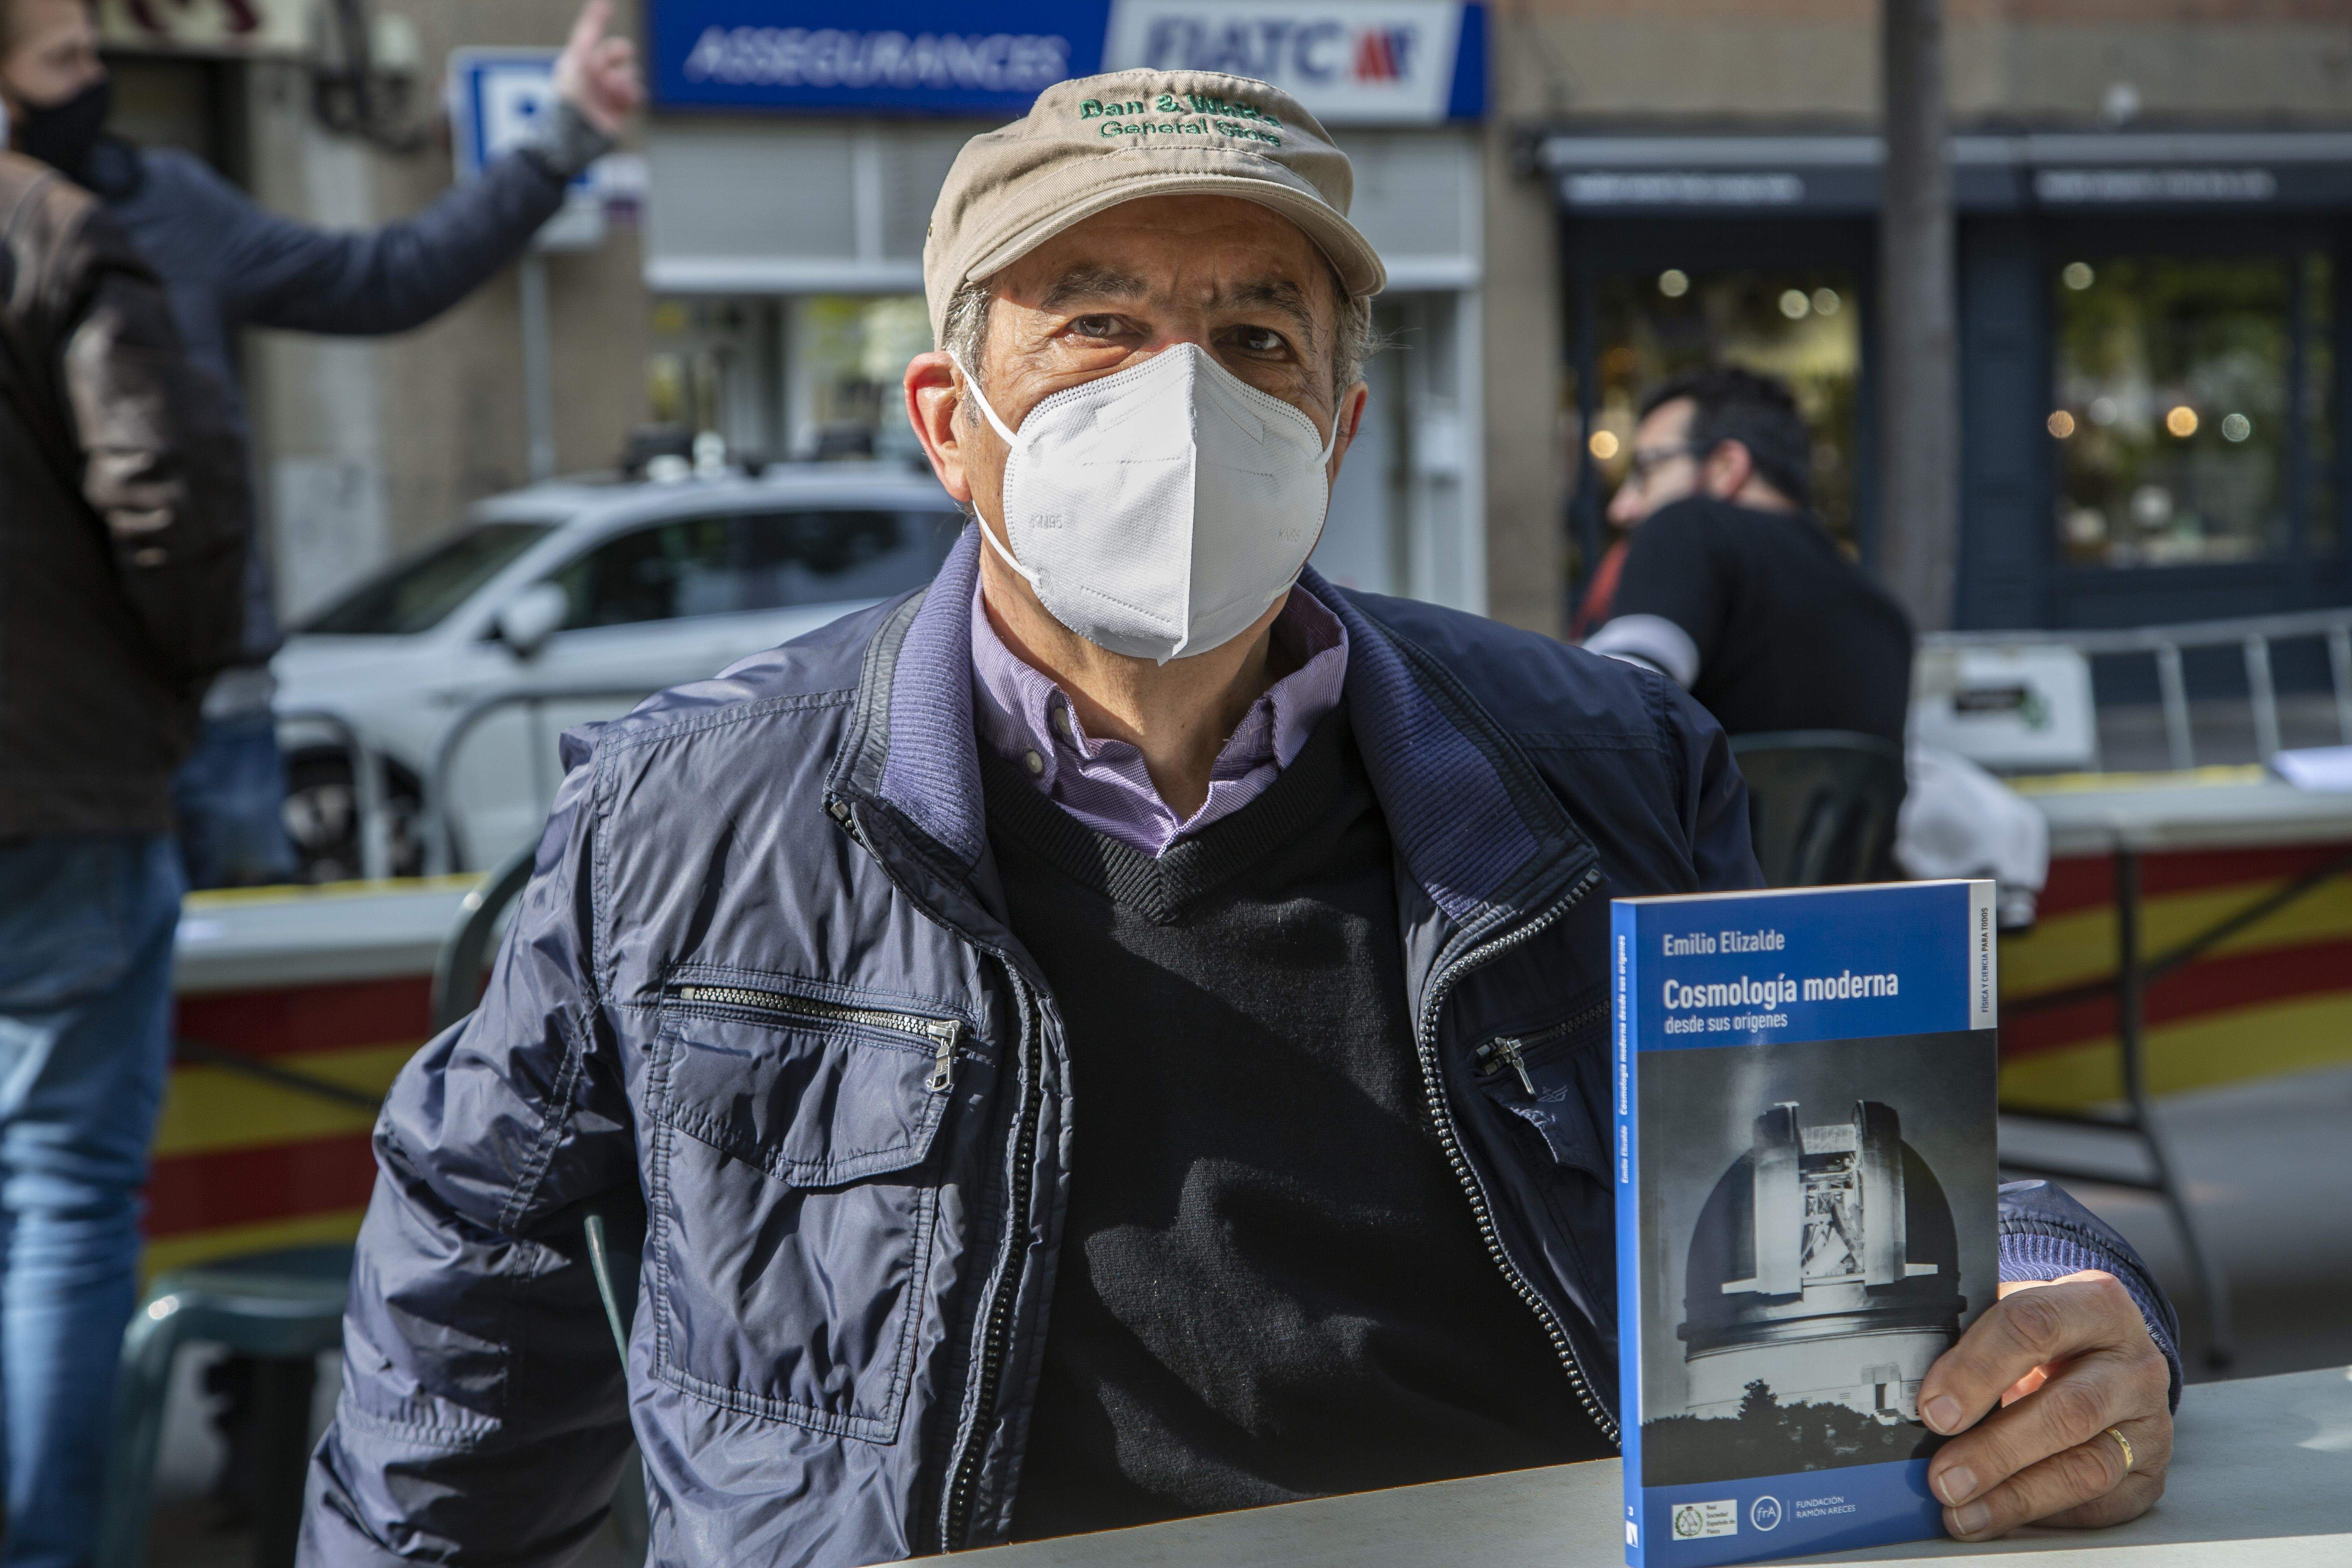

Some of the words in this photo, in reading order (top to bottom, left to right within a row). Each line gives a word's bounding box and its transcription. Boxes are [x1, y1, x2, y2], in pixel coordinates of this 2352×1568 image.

[684, 25, 1071, 91] ASSEGURANCES
[1079, 98, 1143, 119] Dan
[1156, 94, 1183, 113] &
[1099, 118, 1207, 138] General
[1216, 120, 1281, 147] Store
[1663, 933, 1716, 956] Emilio
[1720, 929, 1785, 953] Elizalde
[1664, 973, 1797, 1010] Cosmología
[1803, 969, 1898, 1001] moderna
[1981, 989, 1989, 1013] FÍSICA
[1618, 993, 1626, 1021] desde
[1664, 1016, 1704, 1034] desde
[1706, 1017, 1731, 1032] sus
[1733, 1011, 1788, 1033] orígenes
[1797, 1496, 1844, 1508] FUNDACIÓN
[1797, 1508, 1826, 1518] RAMÓN
[1828, 1505, 1856, 1515] ARECES
